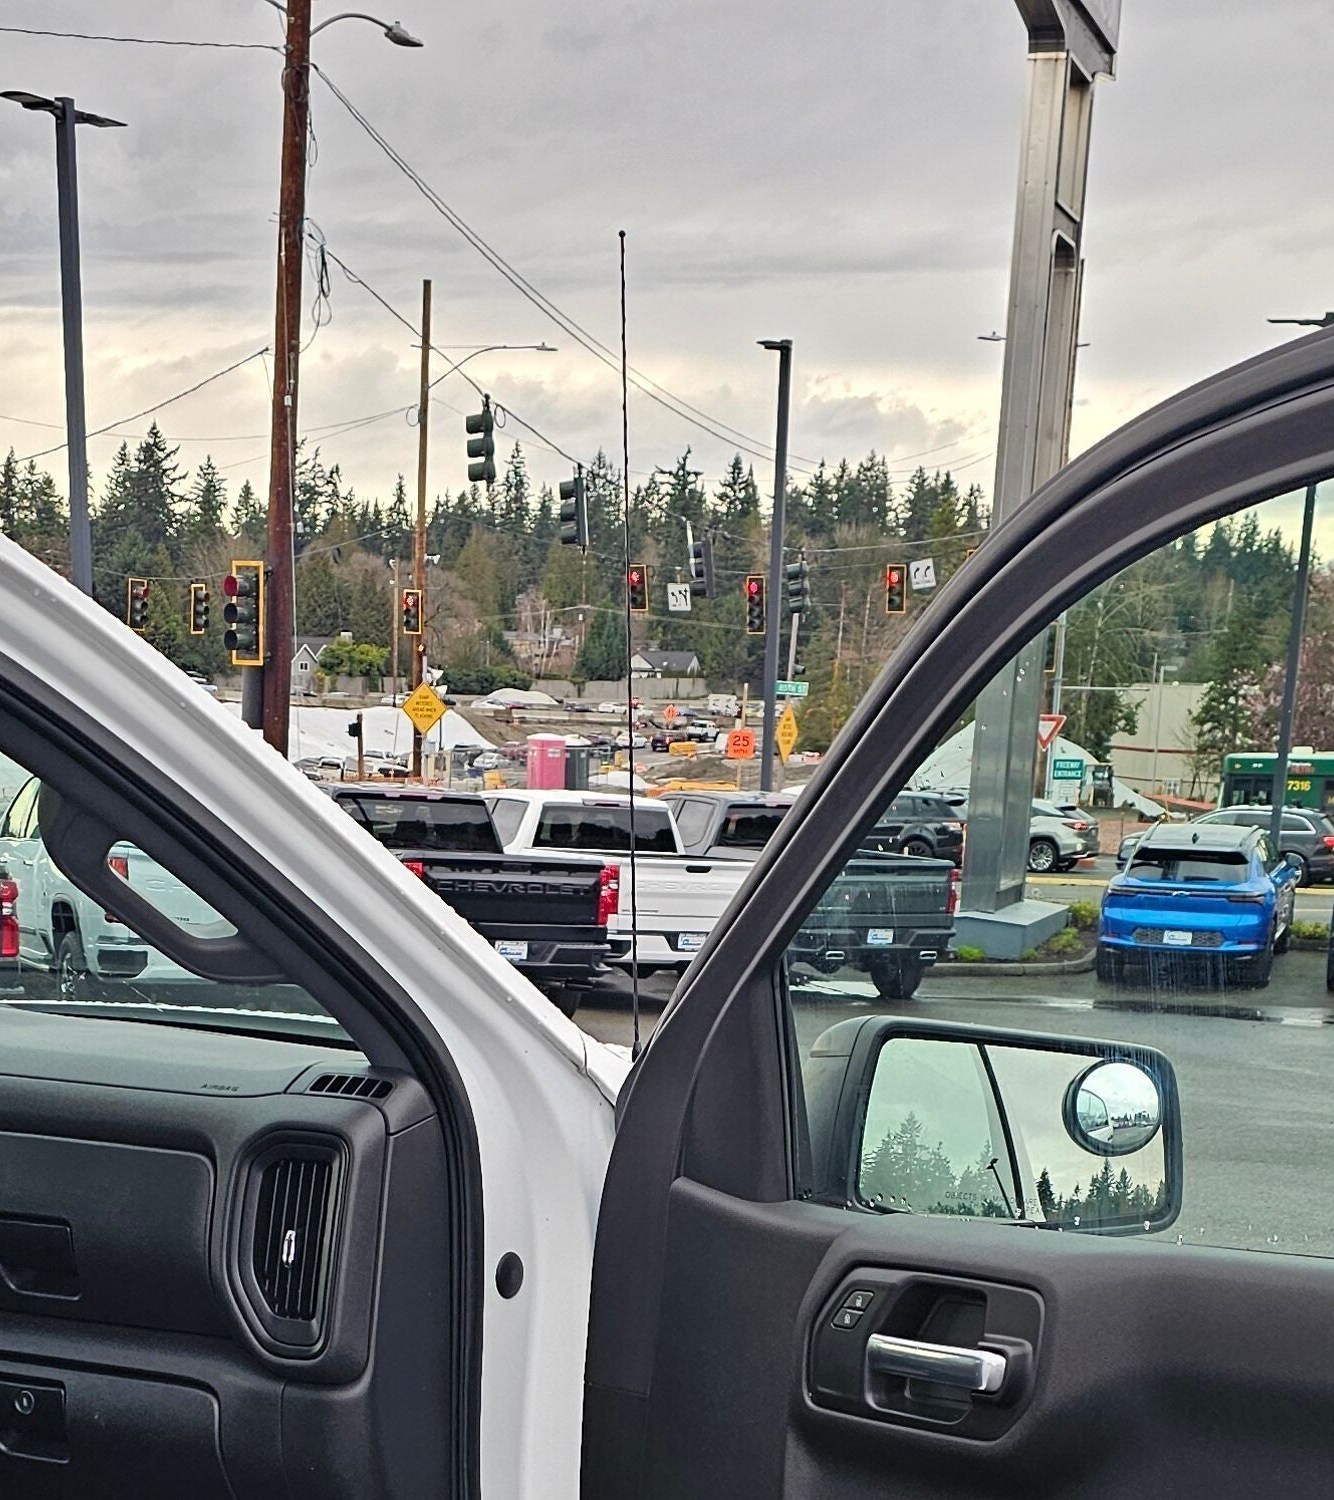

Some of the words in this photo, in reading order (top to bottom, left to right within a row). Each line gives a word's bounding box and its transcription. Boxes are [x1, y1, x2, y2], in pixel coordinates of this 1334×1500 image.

[732, 735, 750, 747] 25
[1056, 761, 1081, 769] FREEWAY
[1053, 770, 1083, 778] ENTRANCE
[1287, 780, 1312, 791] 7316
[437, 880, 590, 896] CHEVROLET
